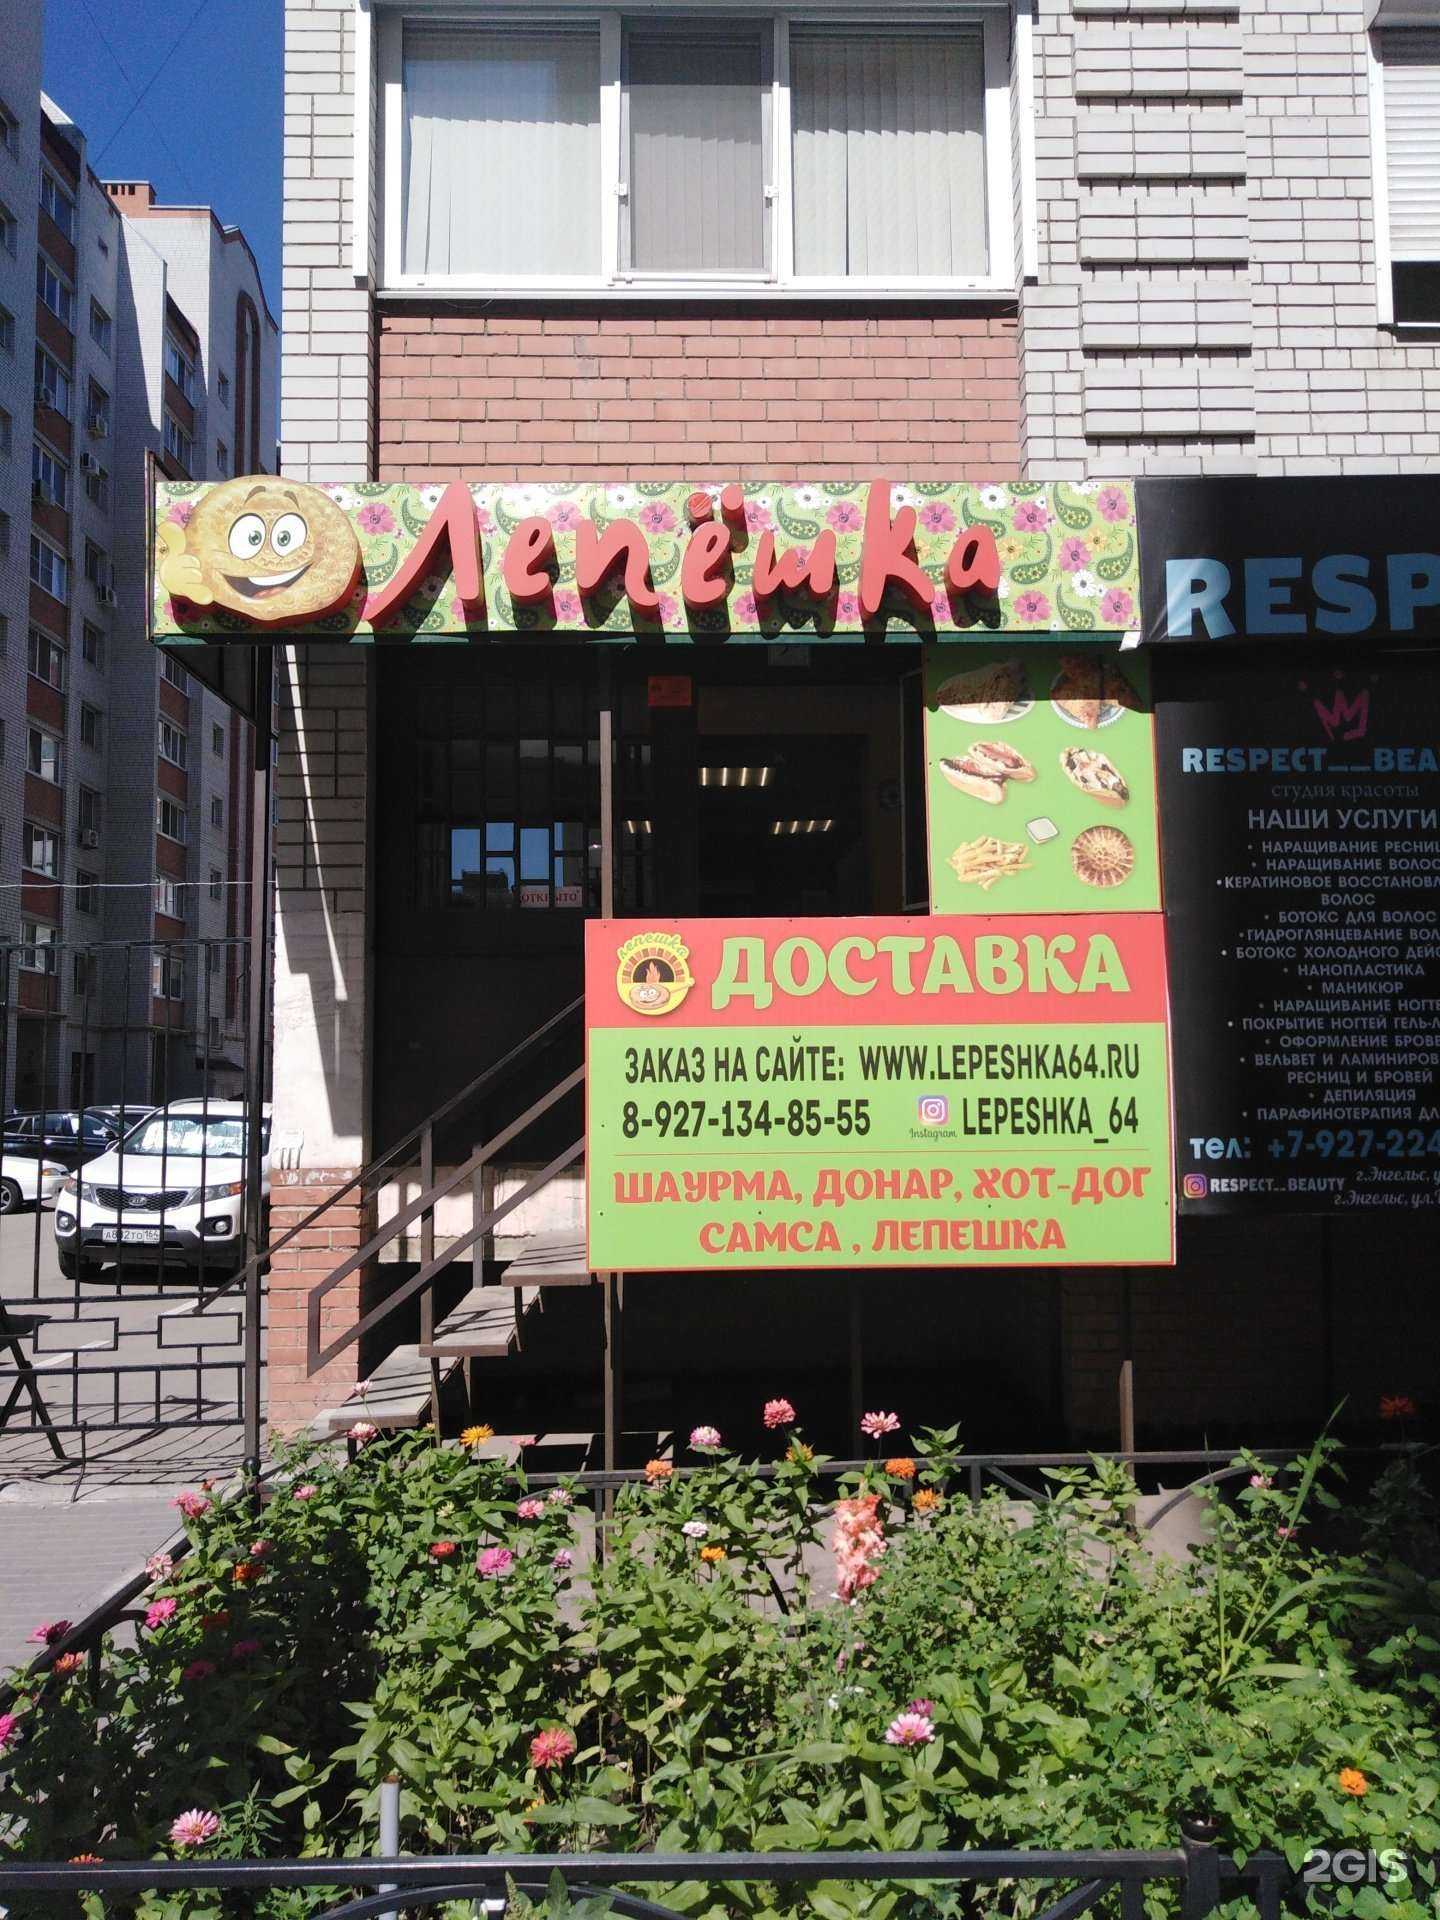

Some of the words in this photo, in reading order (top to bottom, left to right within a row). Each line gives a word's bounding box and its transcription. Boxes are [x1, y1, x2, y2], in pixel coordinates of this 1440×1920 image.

[362, 477, 1002, 624] Лепёшка
[1271, 785, 1337, 802] студия
[1341, 785, 1420, 802] красоты
[1248, 808, 1329, 831] НАШИ
[1336, 808, 1438, 829] УСЛУГИ
[1262, 841, 1379, 855] НАРАЩИВАНИЕ
[1266, 859, 1382, 873] НАРАЩИВАНИЕ
[1389, 859, 1440, 871] ВОЛОС
[1225, 876, 1332, 889] КЕРАТИНОВОЕ
[1321, 893, 1376, 906] ВОЛОС
[1279, 911, 1339, 923] БОТОКС
[1346, 911, 1376, 925] ДЛЯ
[1382, 910, 1437, 923] ВОЛОС
[1248, 929, 1403, 943] ГИДРОГЛЯНЦЕВАНИЕ
[1236, 946, 1297, 959] БОТОКС
[1304, 946, 1400, 960] ХОЛОДНОГО
[711, 934, 1130, 1010] ДОСТАВКА
[1298, 964, 1425, 976] НАНОПЛАСТИКА
[1322, 981, 1404, 994] МАНИКЮР
[1273, 999, 1391, 1014] НАРАЩИВАНИЕ
[1242, 1017, 1324, 1030] ПОКРЫТИЕ
[1331, 1014, 1390, 1030] НОГТЕЙ
[1280, 1035, 1388, 1048] ОФОРМЛЕНИЕ
[624, 1047, 705, 1083] ЗАКАЗ
[714, 1045, 748, 1082] НА
[755, 1034, 845, 1081] САЙТЕ:
[859, 1043, 1139, 1080] WWW.LEPESHKA64.RU
[1255, 1053, 1316, 1066] ВЕЛЬВЕТ
[1323, 1053, 1333, 1065] И
[1287, 1071, 1350, 1085] РЕСНИЦ
[1356, 1071, 1367, 1084] И
[1374, 1067, 1433, 1083] БРОВЕЙ
[1323, 1089, 1416, 1104] ДЕПИЛЯЦИЯ
[621, 1098, 871, 1138] 8-927-134-85-55
[962, 1095, 1138, 1143] LEPESHKA_64
[1257, 1107, 1412, 1121] ПАРАФИНОТЕРАПИЯ
[909, 1127, 957, 1142] Instagram
[613, 1170, 802, 1205] ШАУРМА,
[812, 1169, 962, 1207] ДОНАР,
[973, 1166, 1151, 1205] ХОТ-ДОГ
[871, 1218, 1066, 1252] ЛЕПЕШКА
